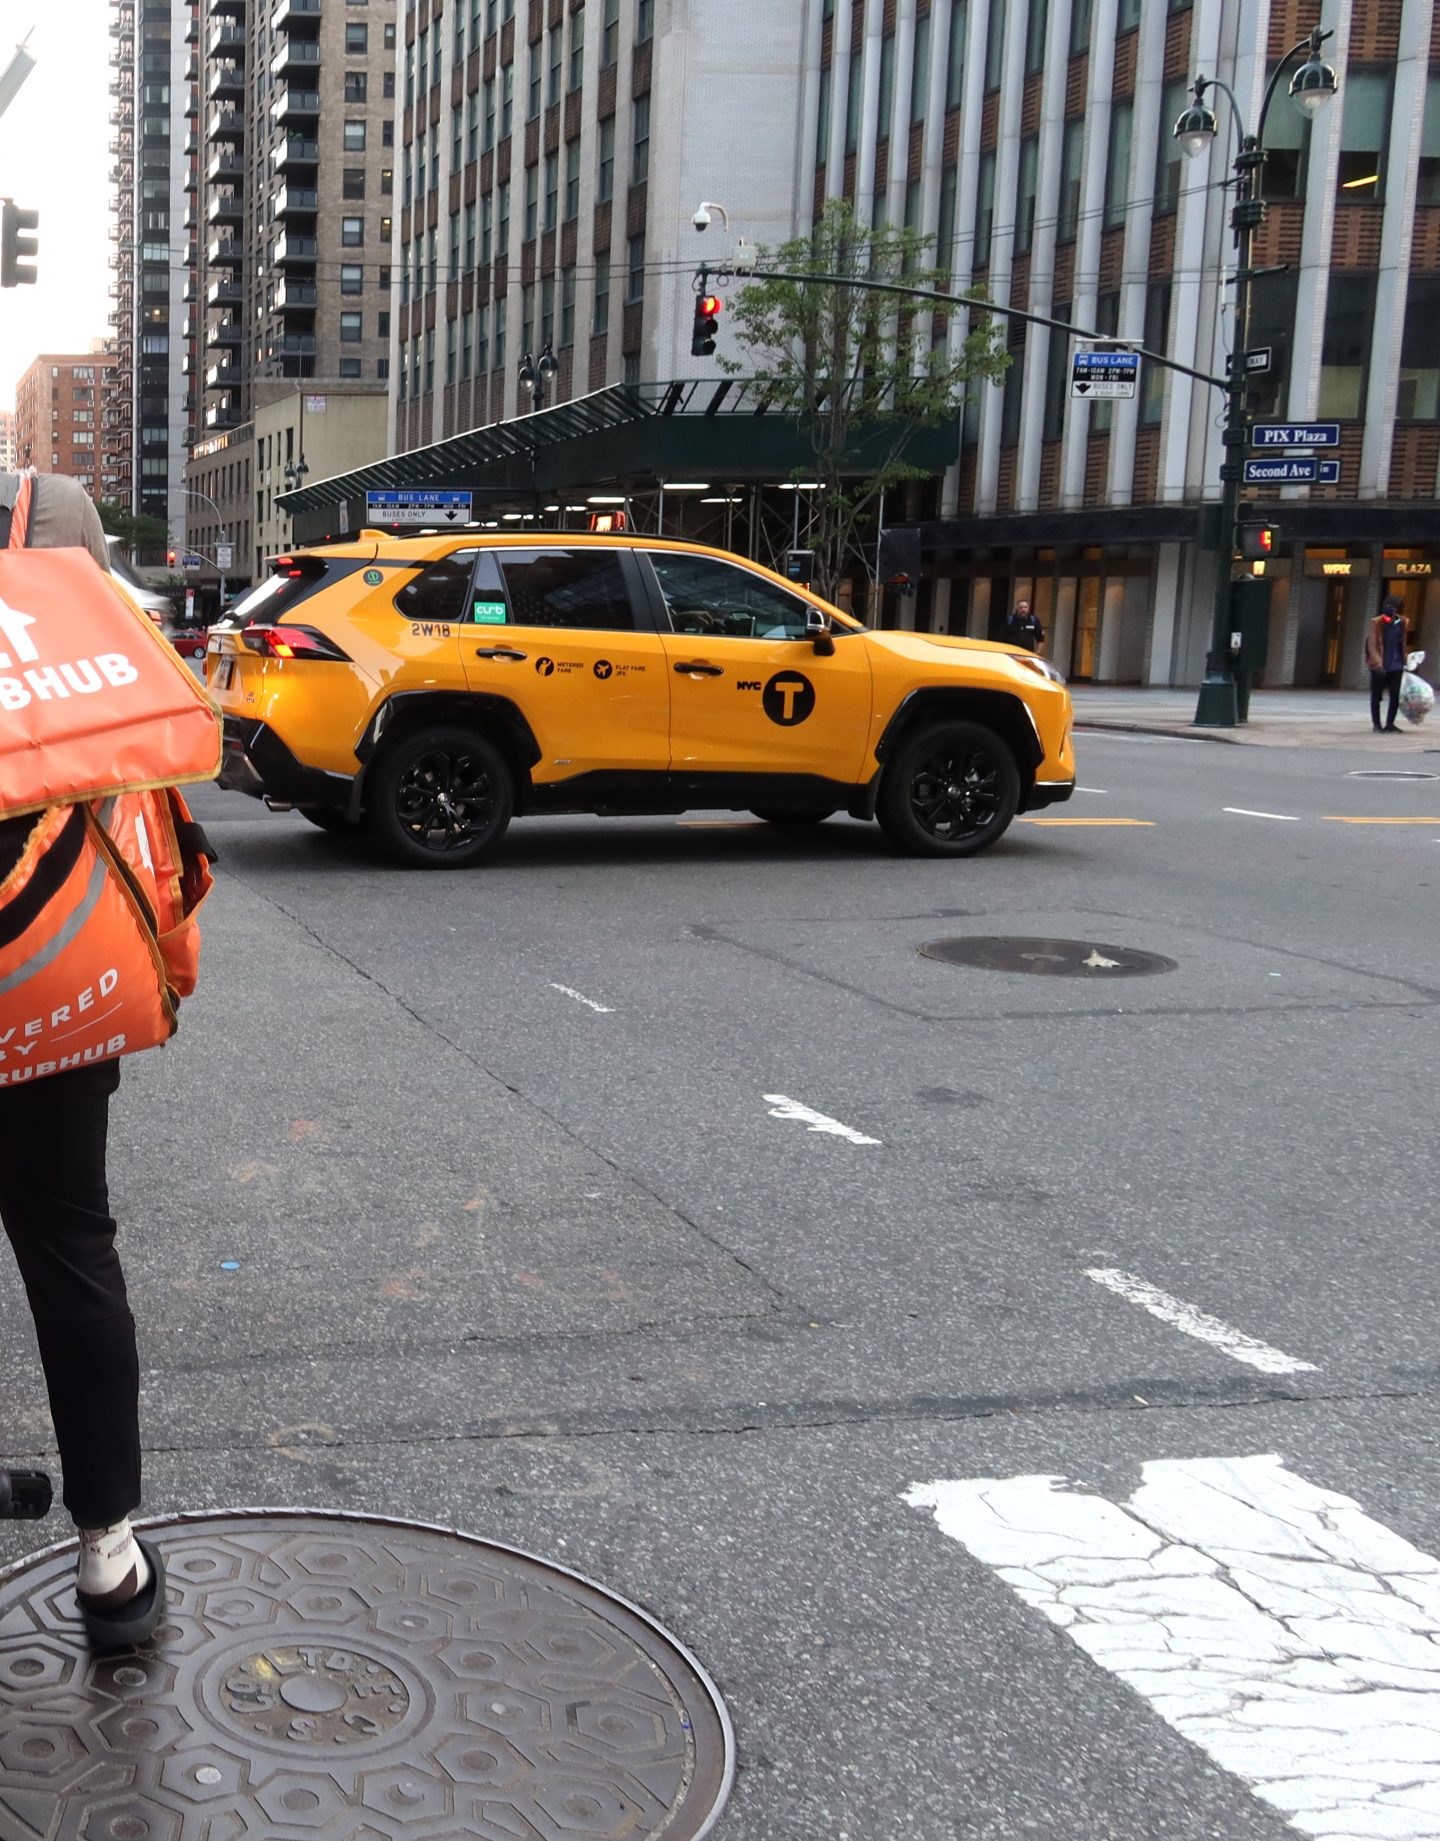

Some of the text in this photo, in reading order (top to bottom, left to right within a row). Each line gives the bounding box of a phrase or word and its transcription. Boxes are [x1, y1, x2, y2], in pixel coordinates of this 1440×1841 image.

[1091, 356, 1134, 365] BUS LANE
[1264, 429, 1327, 443] PIX Plaza
[1248, 463, 1311, 478] Second Ave
[398, 494, 440, 502] BUS LANE
[1323, 564, 1352, 575] WPIX
[1397, 564, 1432, 574] PLAZA
[477, 604, 504, 615] curb
[411, 623, 451, 638] 2W18
[557, 661, 584, 669] METERED
[737, 681, 761, 691] NYC
[774, 681, 804, 719] T
